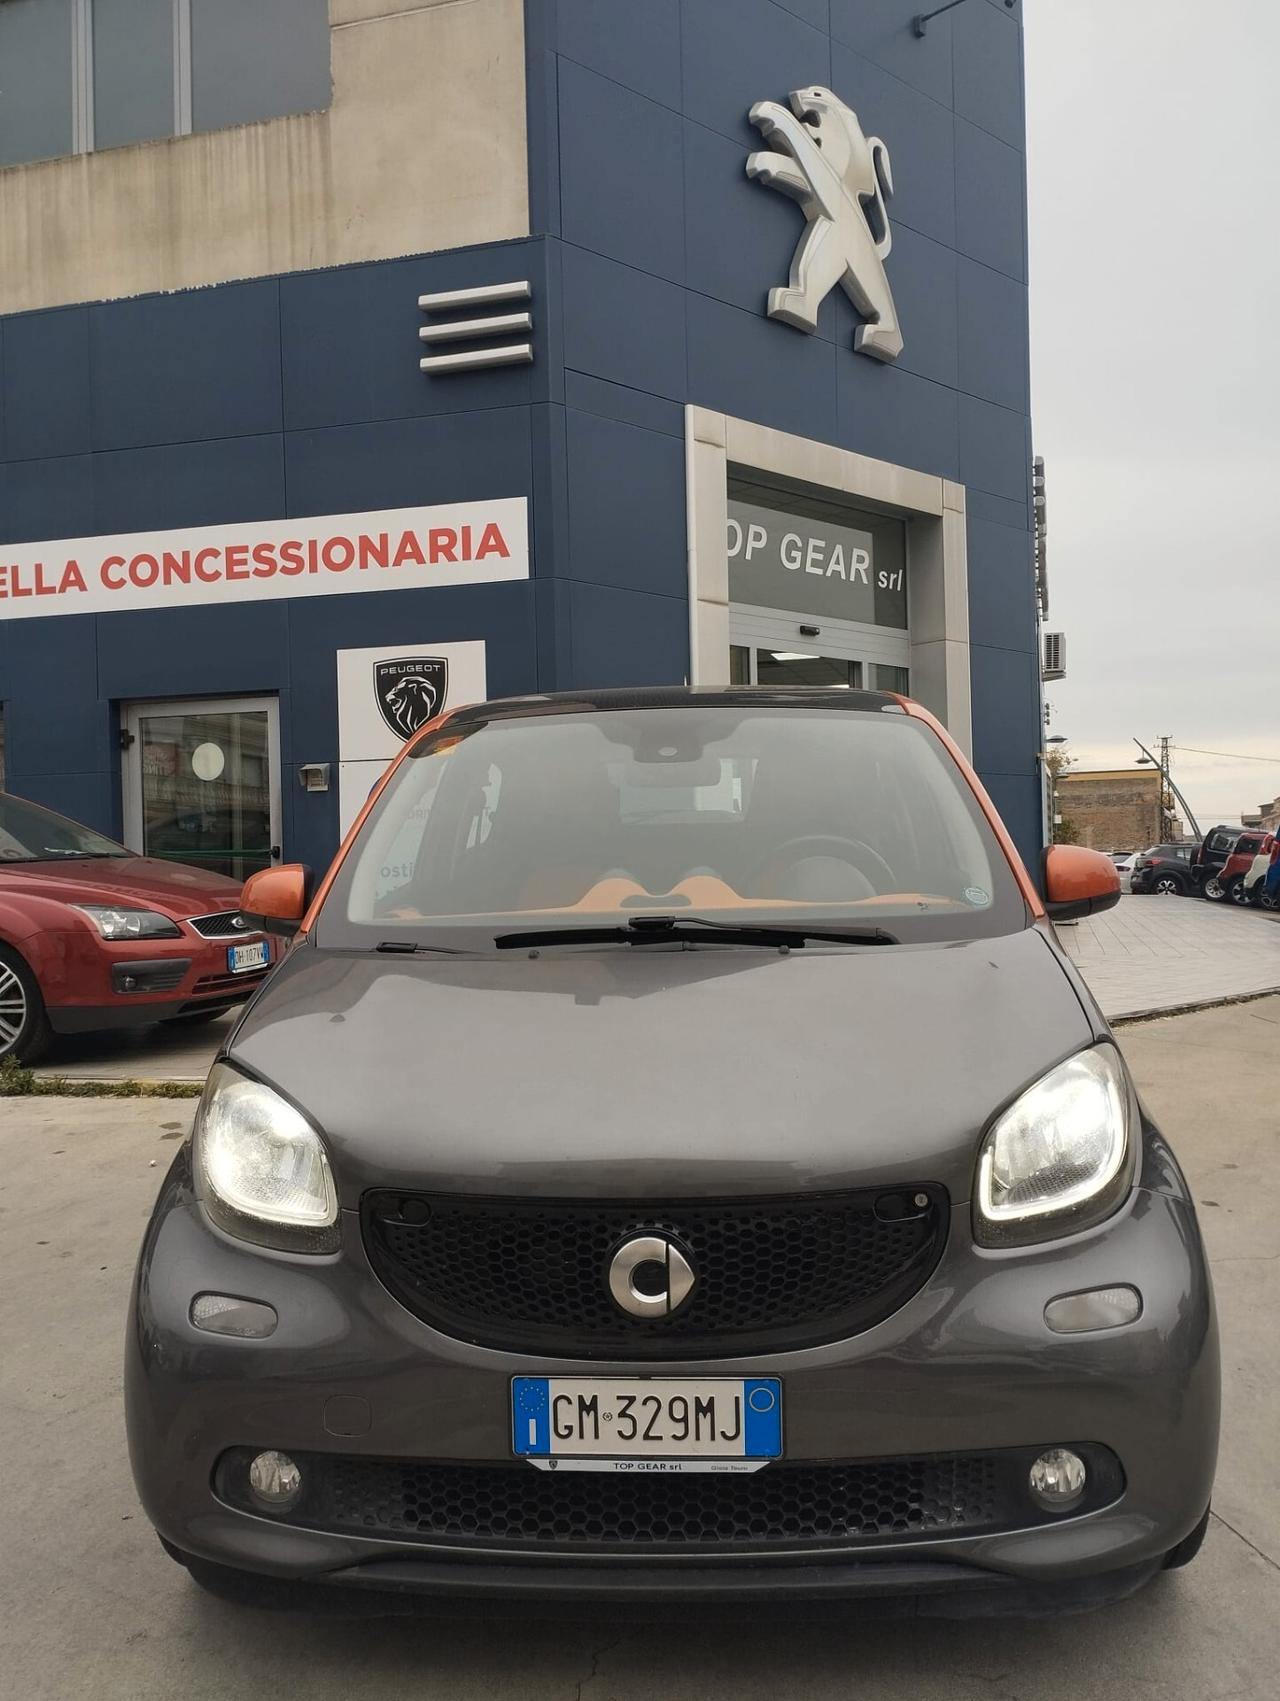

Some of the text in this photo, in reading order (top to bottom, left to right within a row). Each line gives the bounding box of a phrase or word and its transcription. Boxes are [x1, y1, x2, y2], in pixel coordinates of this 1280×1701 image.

[100, 522, 511, 590] CONCESSIONARIA
[780, 532, 871, 585] GEAR
[878, 569, 903, 591] srl
[380, 664, 441, 676] PEUGEOT
[613, 1462, 634, 1471] TOP
[637, 1462, 667, 1471] GEAR
[669, 1463, 682, 1471] srl
